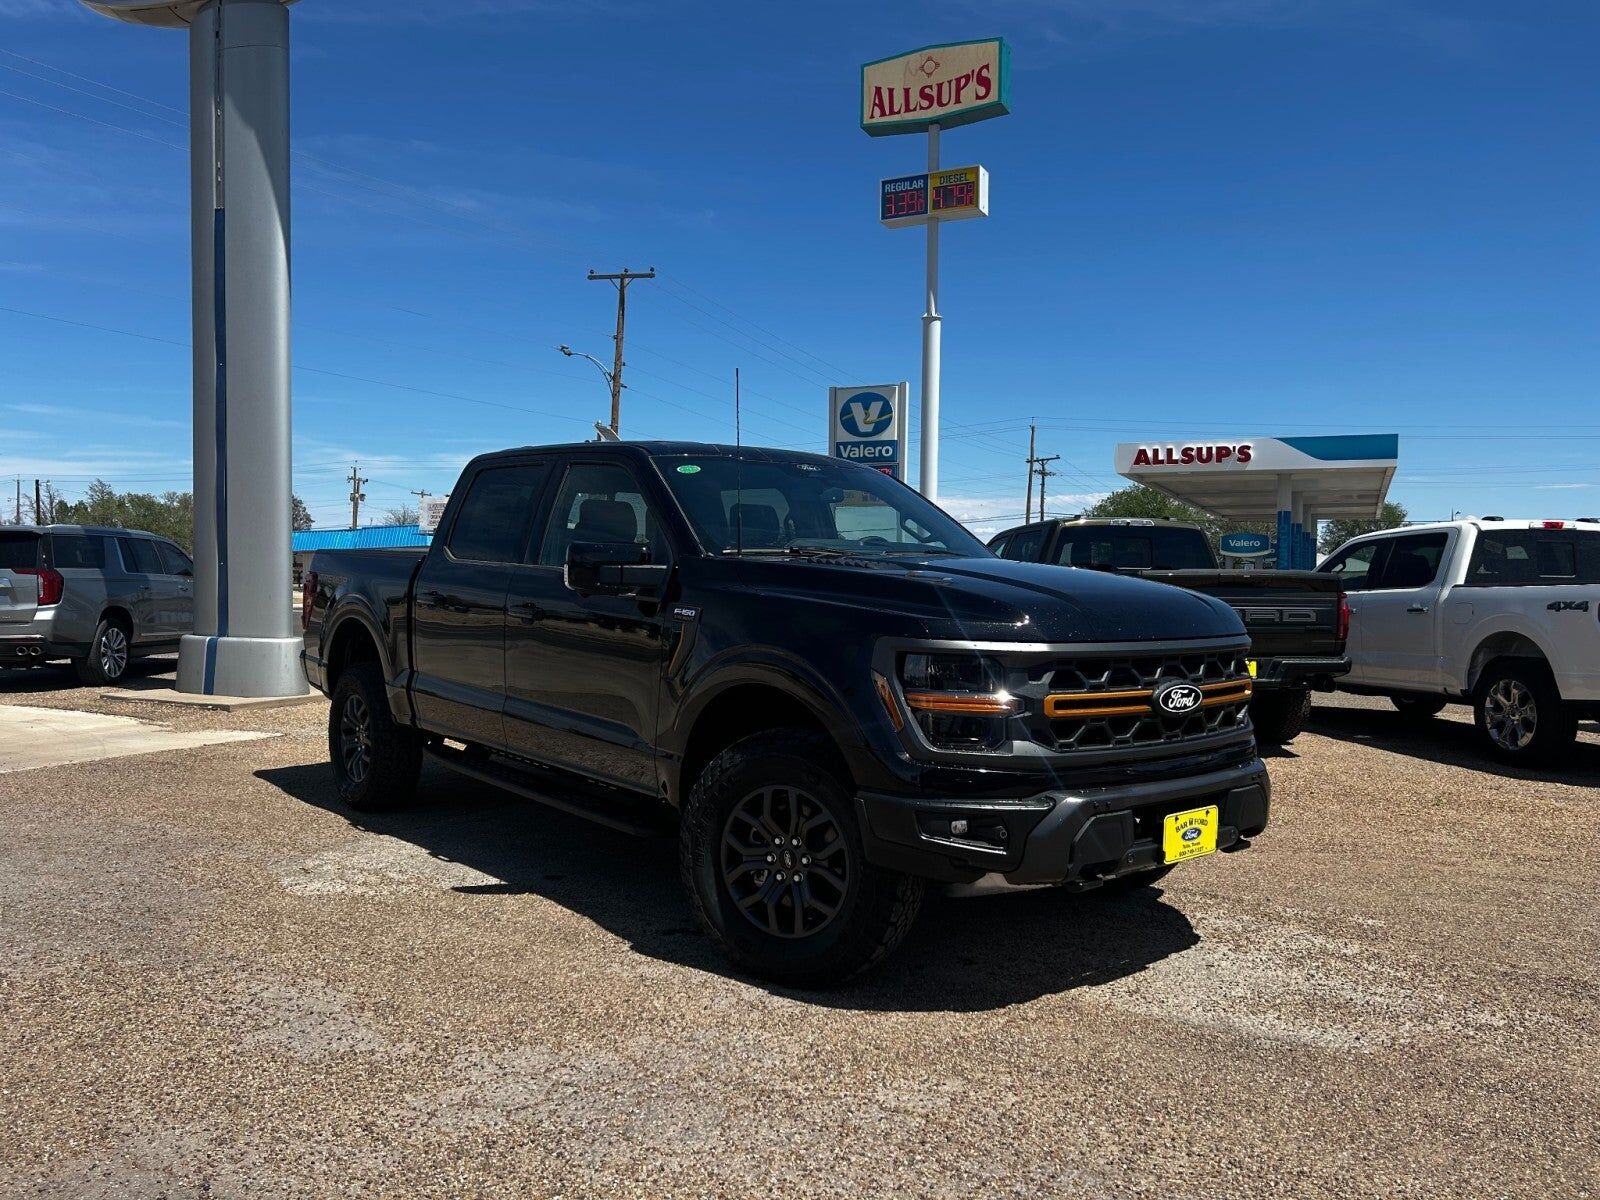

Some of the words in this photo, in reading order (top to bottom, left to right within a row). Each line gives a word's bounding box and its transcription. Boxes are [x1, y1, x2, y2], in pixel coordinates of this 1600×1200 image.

[869, 63, 992, 119] ALLSUP'S
[885, 178, 924, 193] REGULAR
[939, 172, 969, 185] DIESEL
[839, 444, 893, 458] Valero
[1133, 444, 1253, 466] ALLSUP'S
[1229, 538, 1261, 548] Valero
[674, 608, 695, 616] F-150
[1167, 688, 1195, 709] Ford
[1194, 818, 1208, 826] FORD
